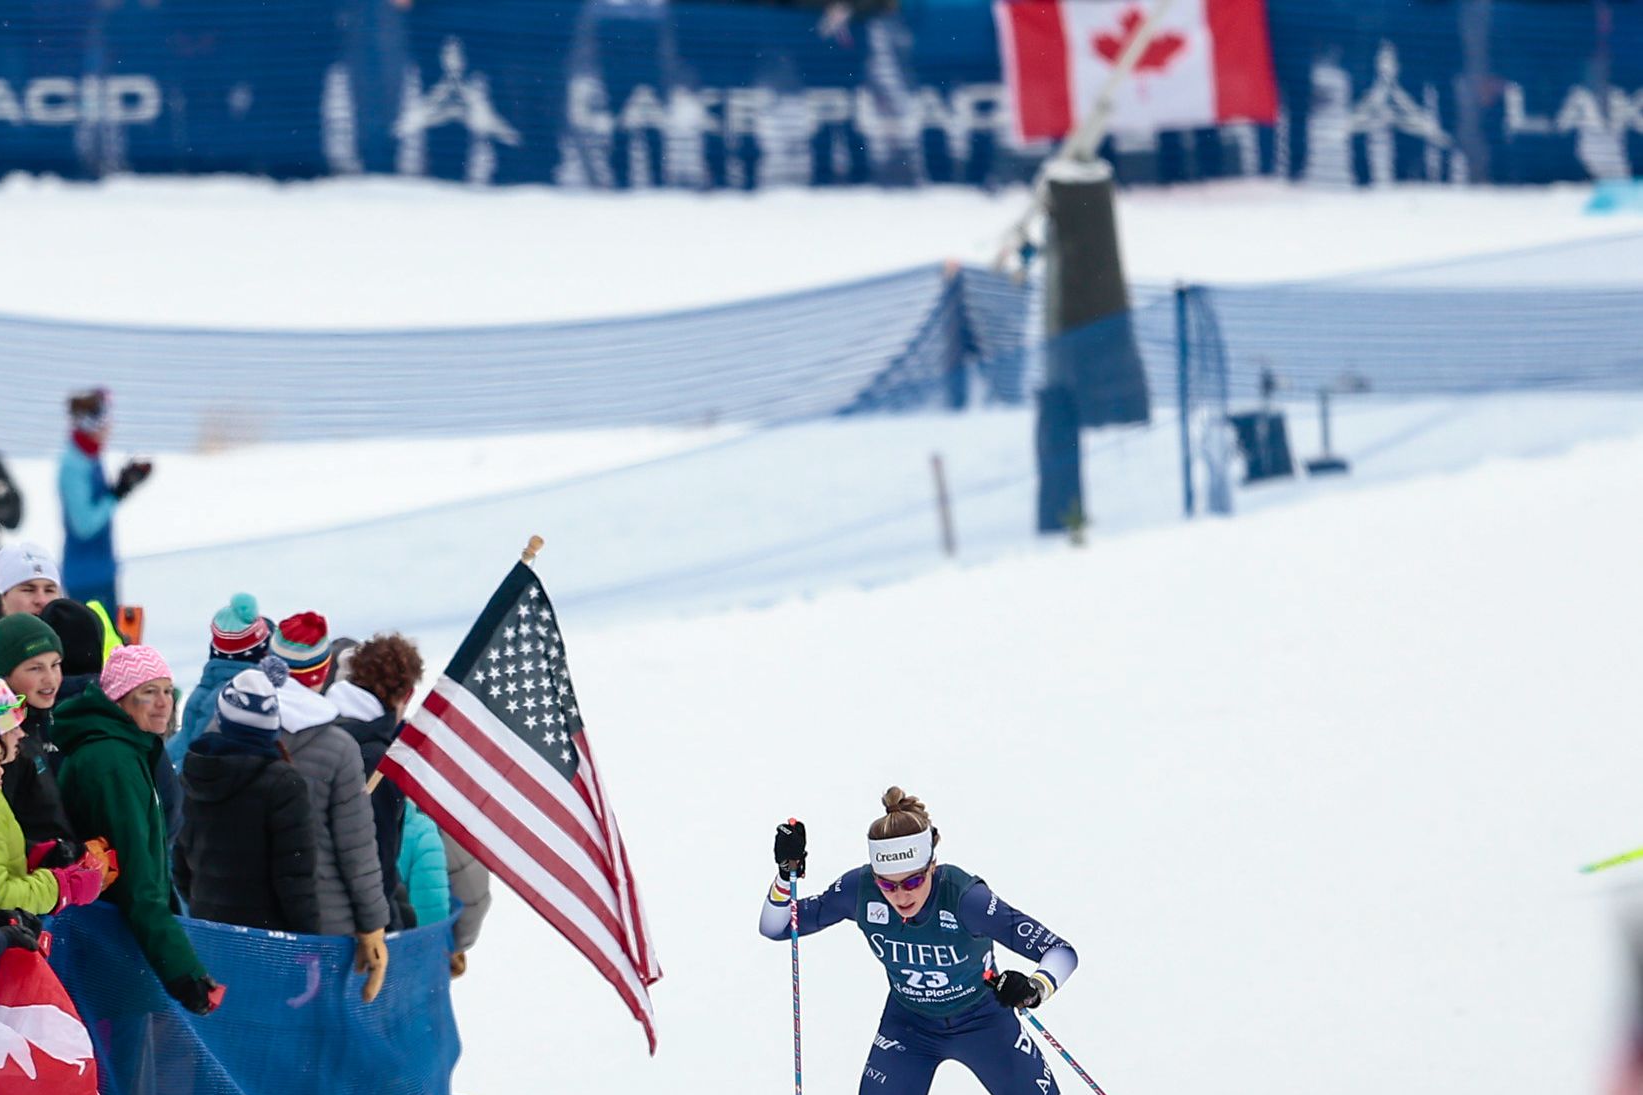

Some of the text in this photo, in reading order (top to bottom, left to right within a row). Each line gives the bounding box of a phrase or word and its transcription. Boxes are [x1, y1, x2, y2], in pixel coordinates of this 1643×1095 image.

[1503, 82, 1643, 134] LAK
[875, 848, 915, 863] Creand
[869, 932, 969, 967] STIFEL
[900, 968, 950, 989] 23
